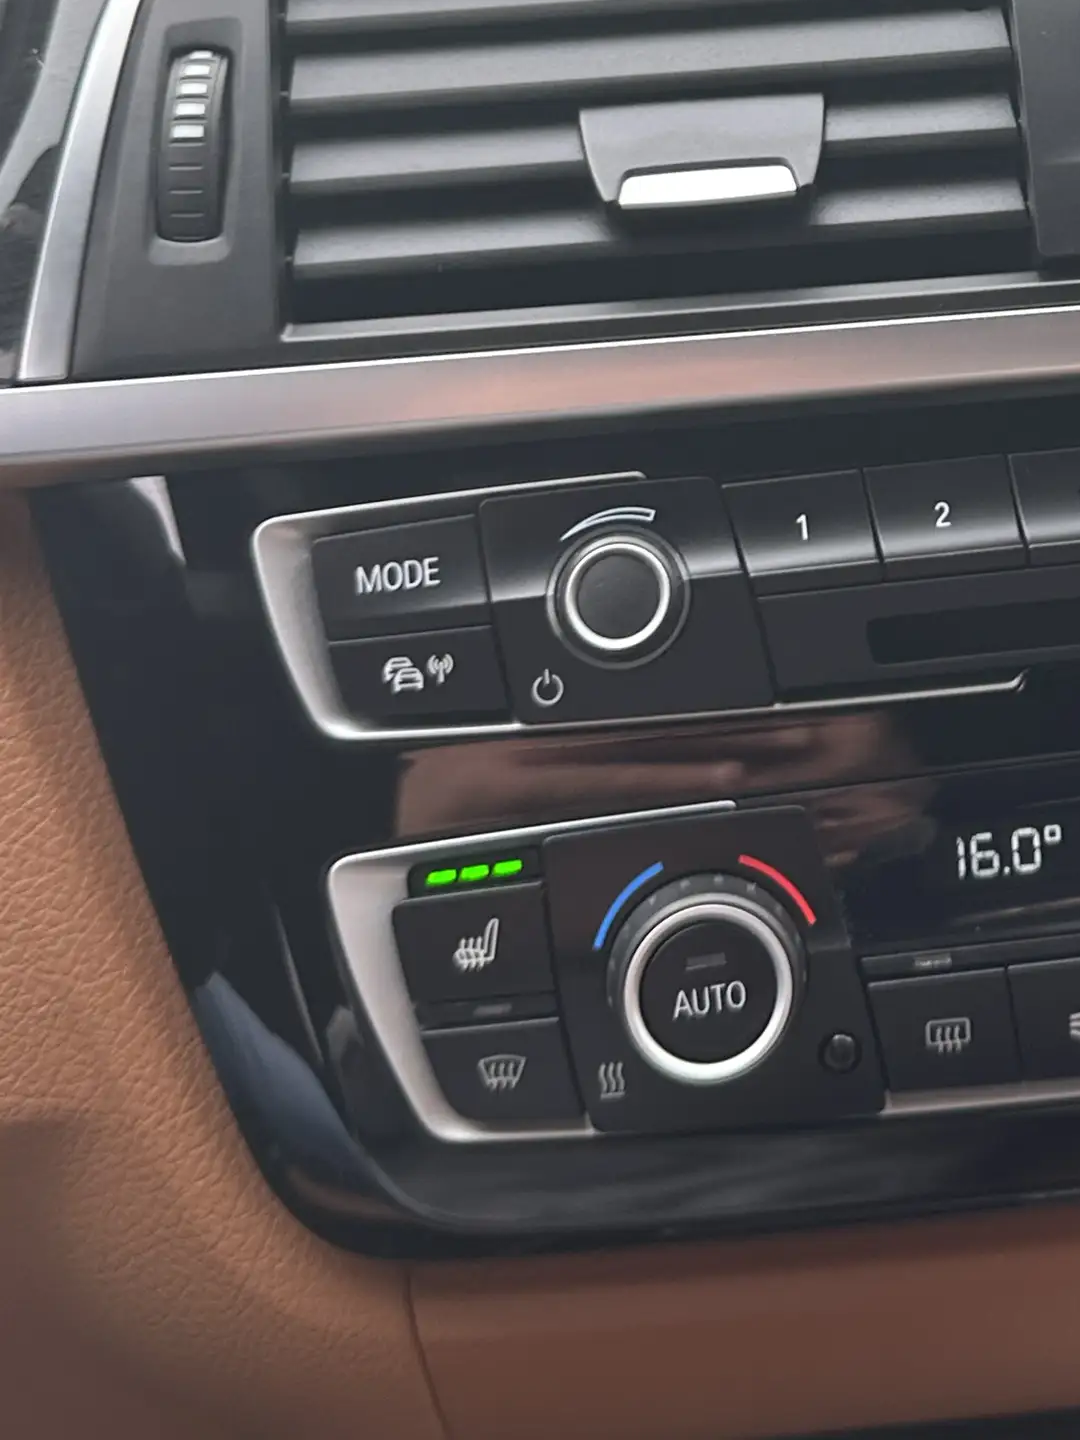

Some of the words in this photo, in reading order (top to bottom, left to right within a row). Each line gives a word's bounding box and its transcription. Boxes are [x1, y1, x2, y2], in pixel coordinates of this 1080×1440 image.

[795, 513, 809, 541] 1
[934, 501, 952, 528] 2
[355, 556, 441, 595] MODE
[672, 980, 746, 1021] AUTO
